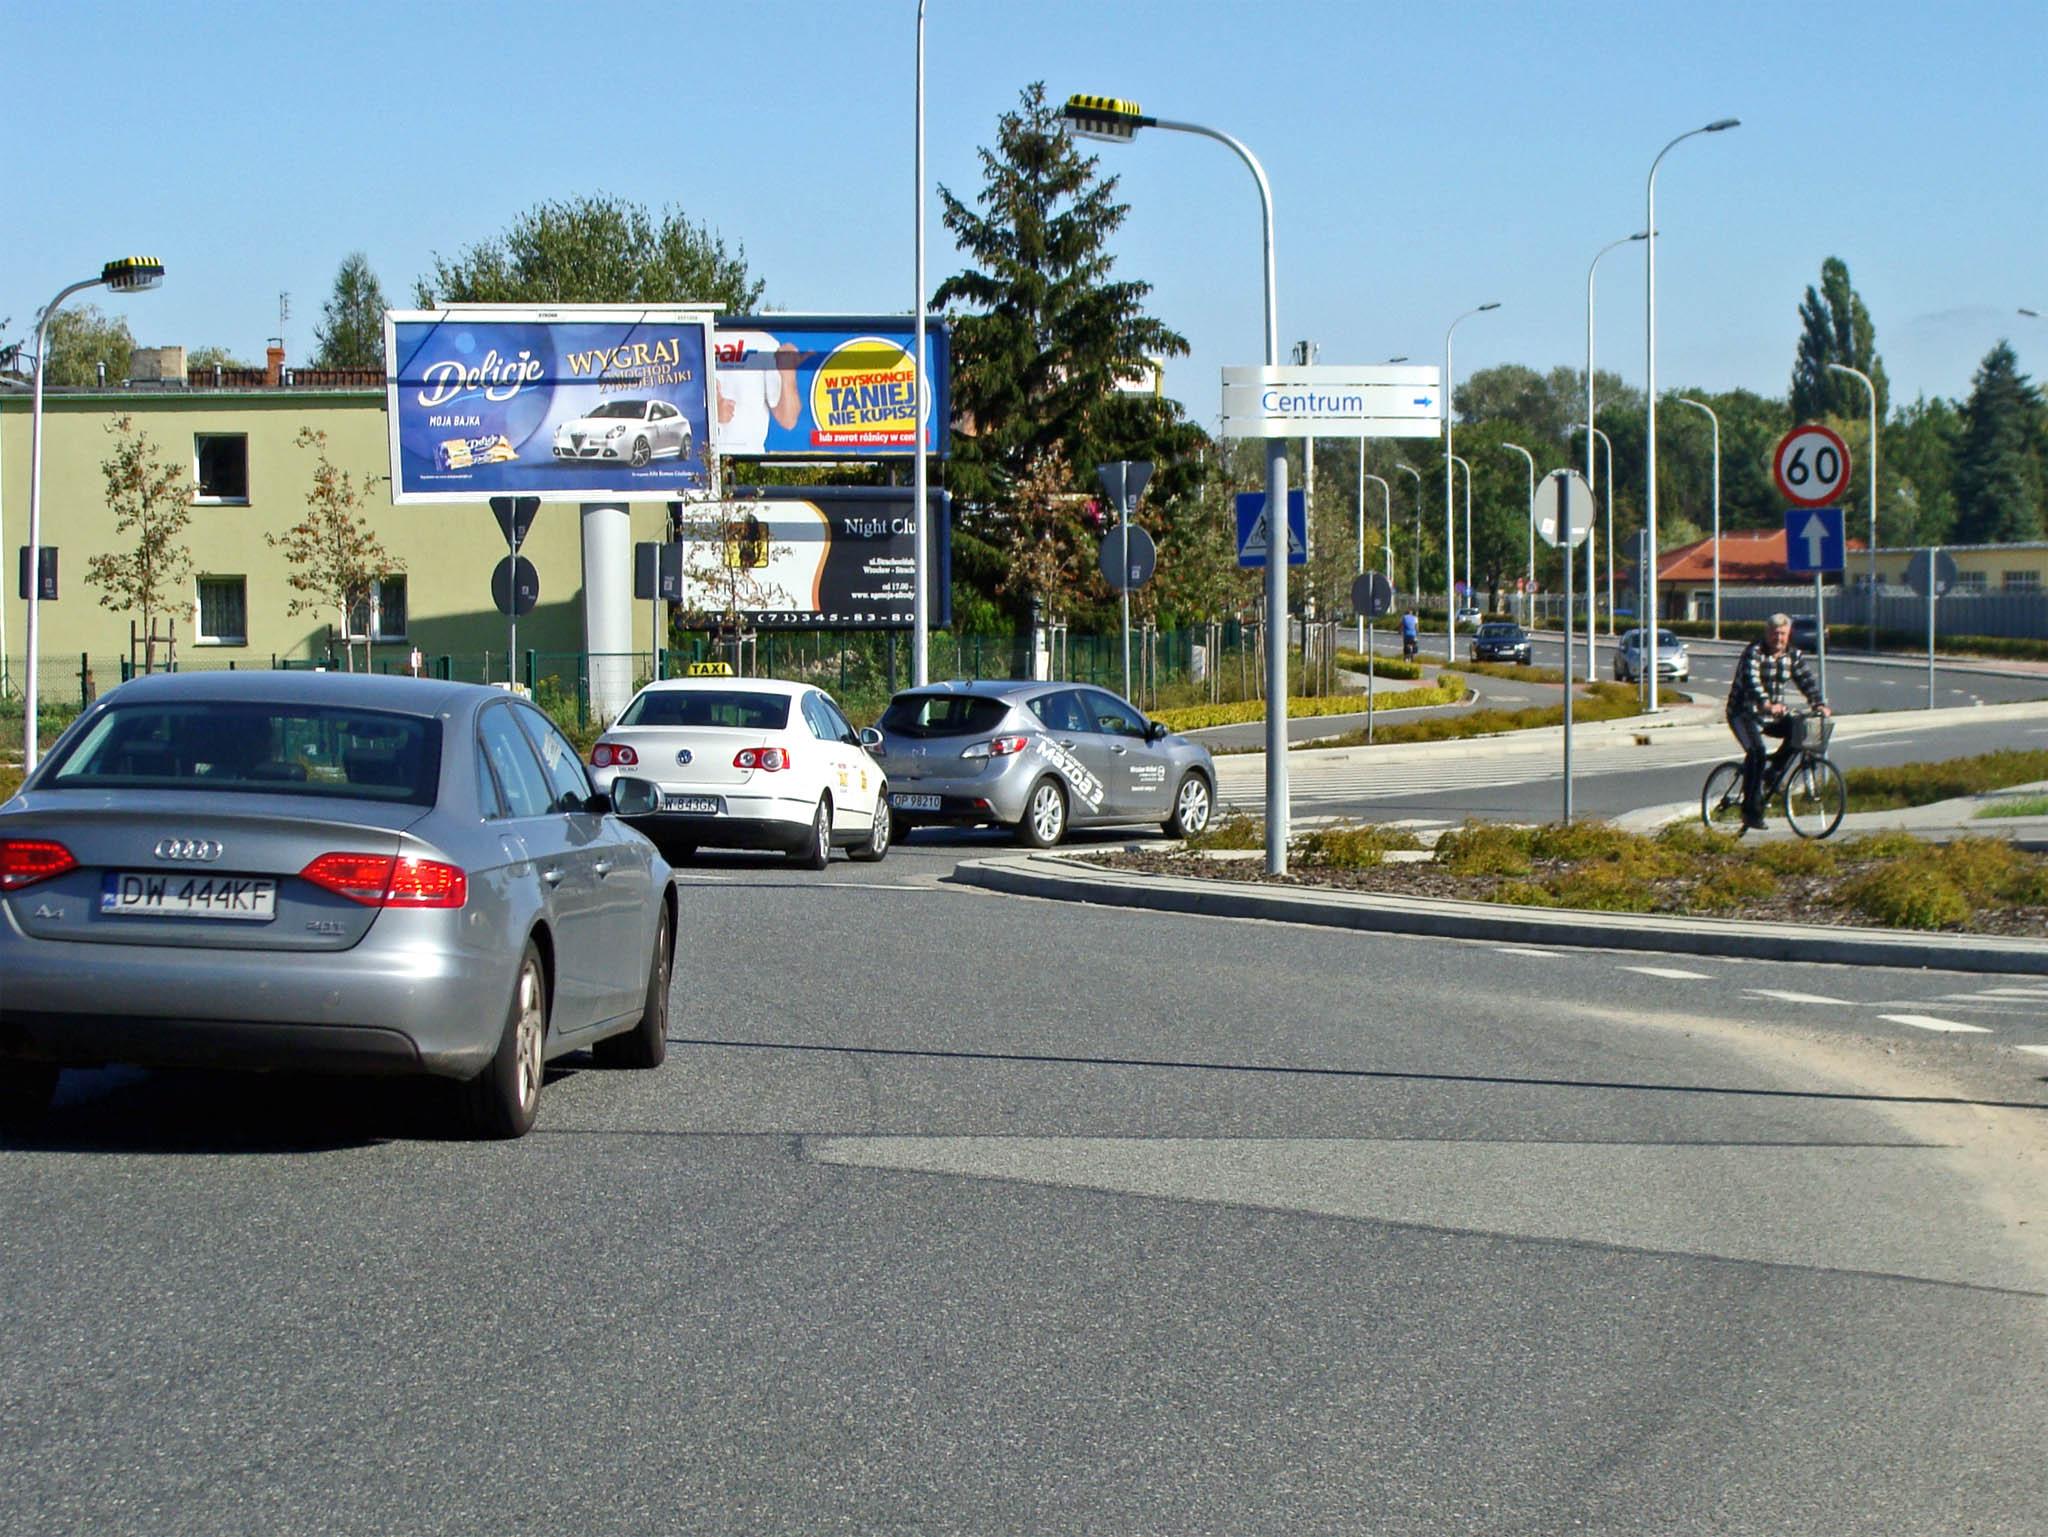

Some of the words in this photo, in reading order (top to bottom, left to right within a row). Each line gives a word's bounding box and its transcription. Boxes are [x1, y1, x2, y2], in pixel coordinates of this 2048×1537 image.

[567, 338, 680, 376] WYGRAJ
[418, 350, 545, 407] Delicje
[658, 370, 692, 385] BAJKI
[825, 378, 838, 388] W
[841, 371, 914, 387] DYSKONCIE
[826, 382, 915, 412] TANIEJ
[1262, 391, 1363, 412] Centrum
[429, 415, 451, 427] MOJA
[454, 415, 480, 427] BAJKA
[828, 411, 856, 426] NIE
[860, 405, 918, 423] KUPISZ
[819, 433, 833, 442] lub
[834, 434, 858, 442] zwrot
[859, 432, 889, 444] różnicy
[890, 434, 899, 442] w
[1787, 447, 1839, 486] 60
[844, 518, 886, 537] Night
[892, 518, 917, 534] Clu
[691, 664, 727, 675] TAXI
[1036, 740, 1093, 795] Mazda
[1089, 788, 1104, 805] 3
[677, 798, 715, 811] 843GK
[123, 876, 167, 906] DW
[178, 879, 273, 910] 444KF
